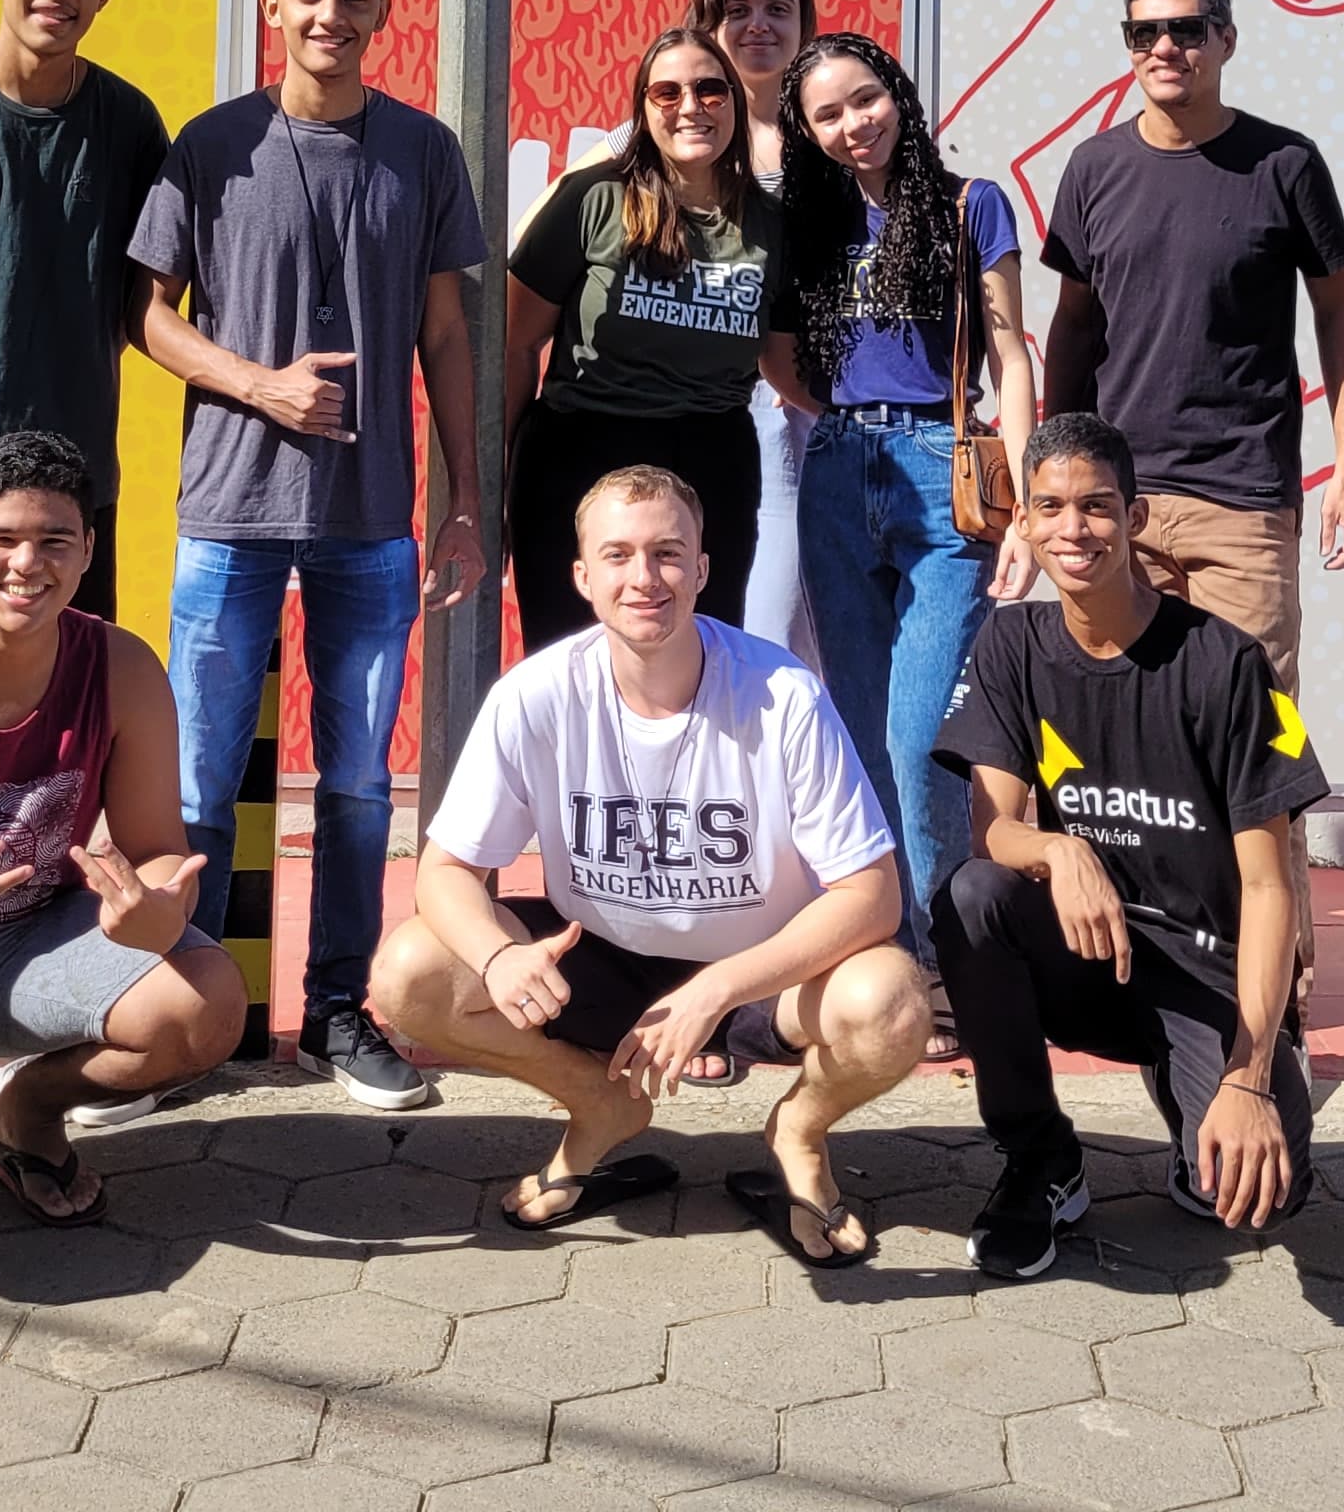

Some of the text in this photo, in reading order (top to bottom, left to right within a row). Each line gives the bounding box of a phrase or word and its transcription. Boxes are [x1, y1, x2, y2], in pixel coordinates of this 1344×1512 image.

[618, 292, 760, 339] ENGENHARIA
[568, 791, 754, 871] IFES
[570, 863, 761, 901] ENGENHARIA
